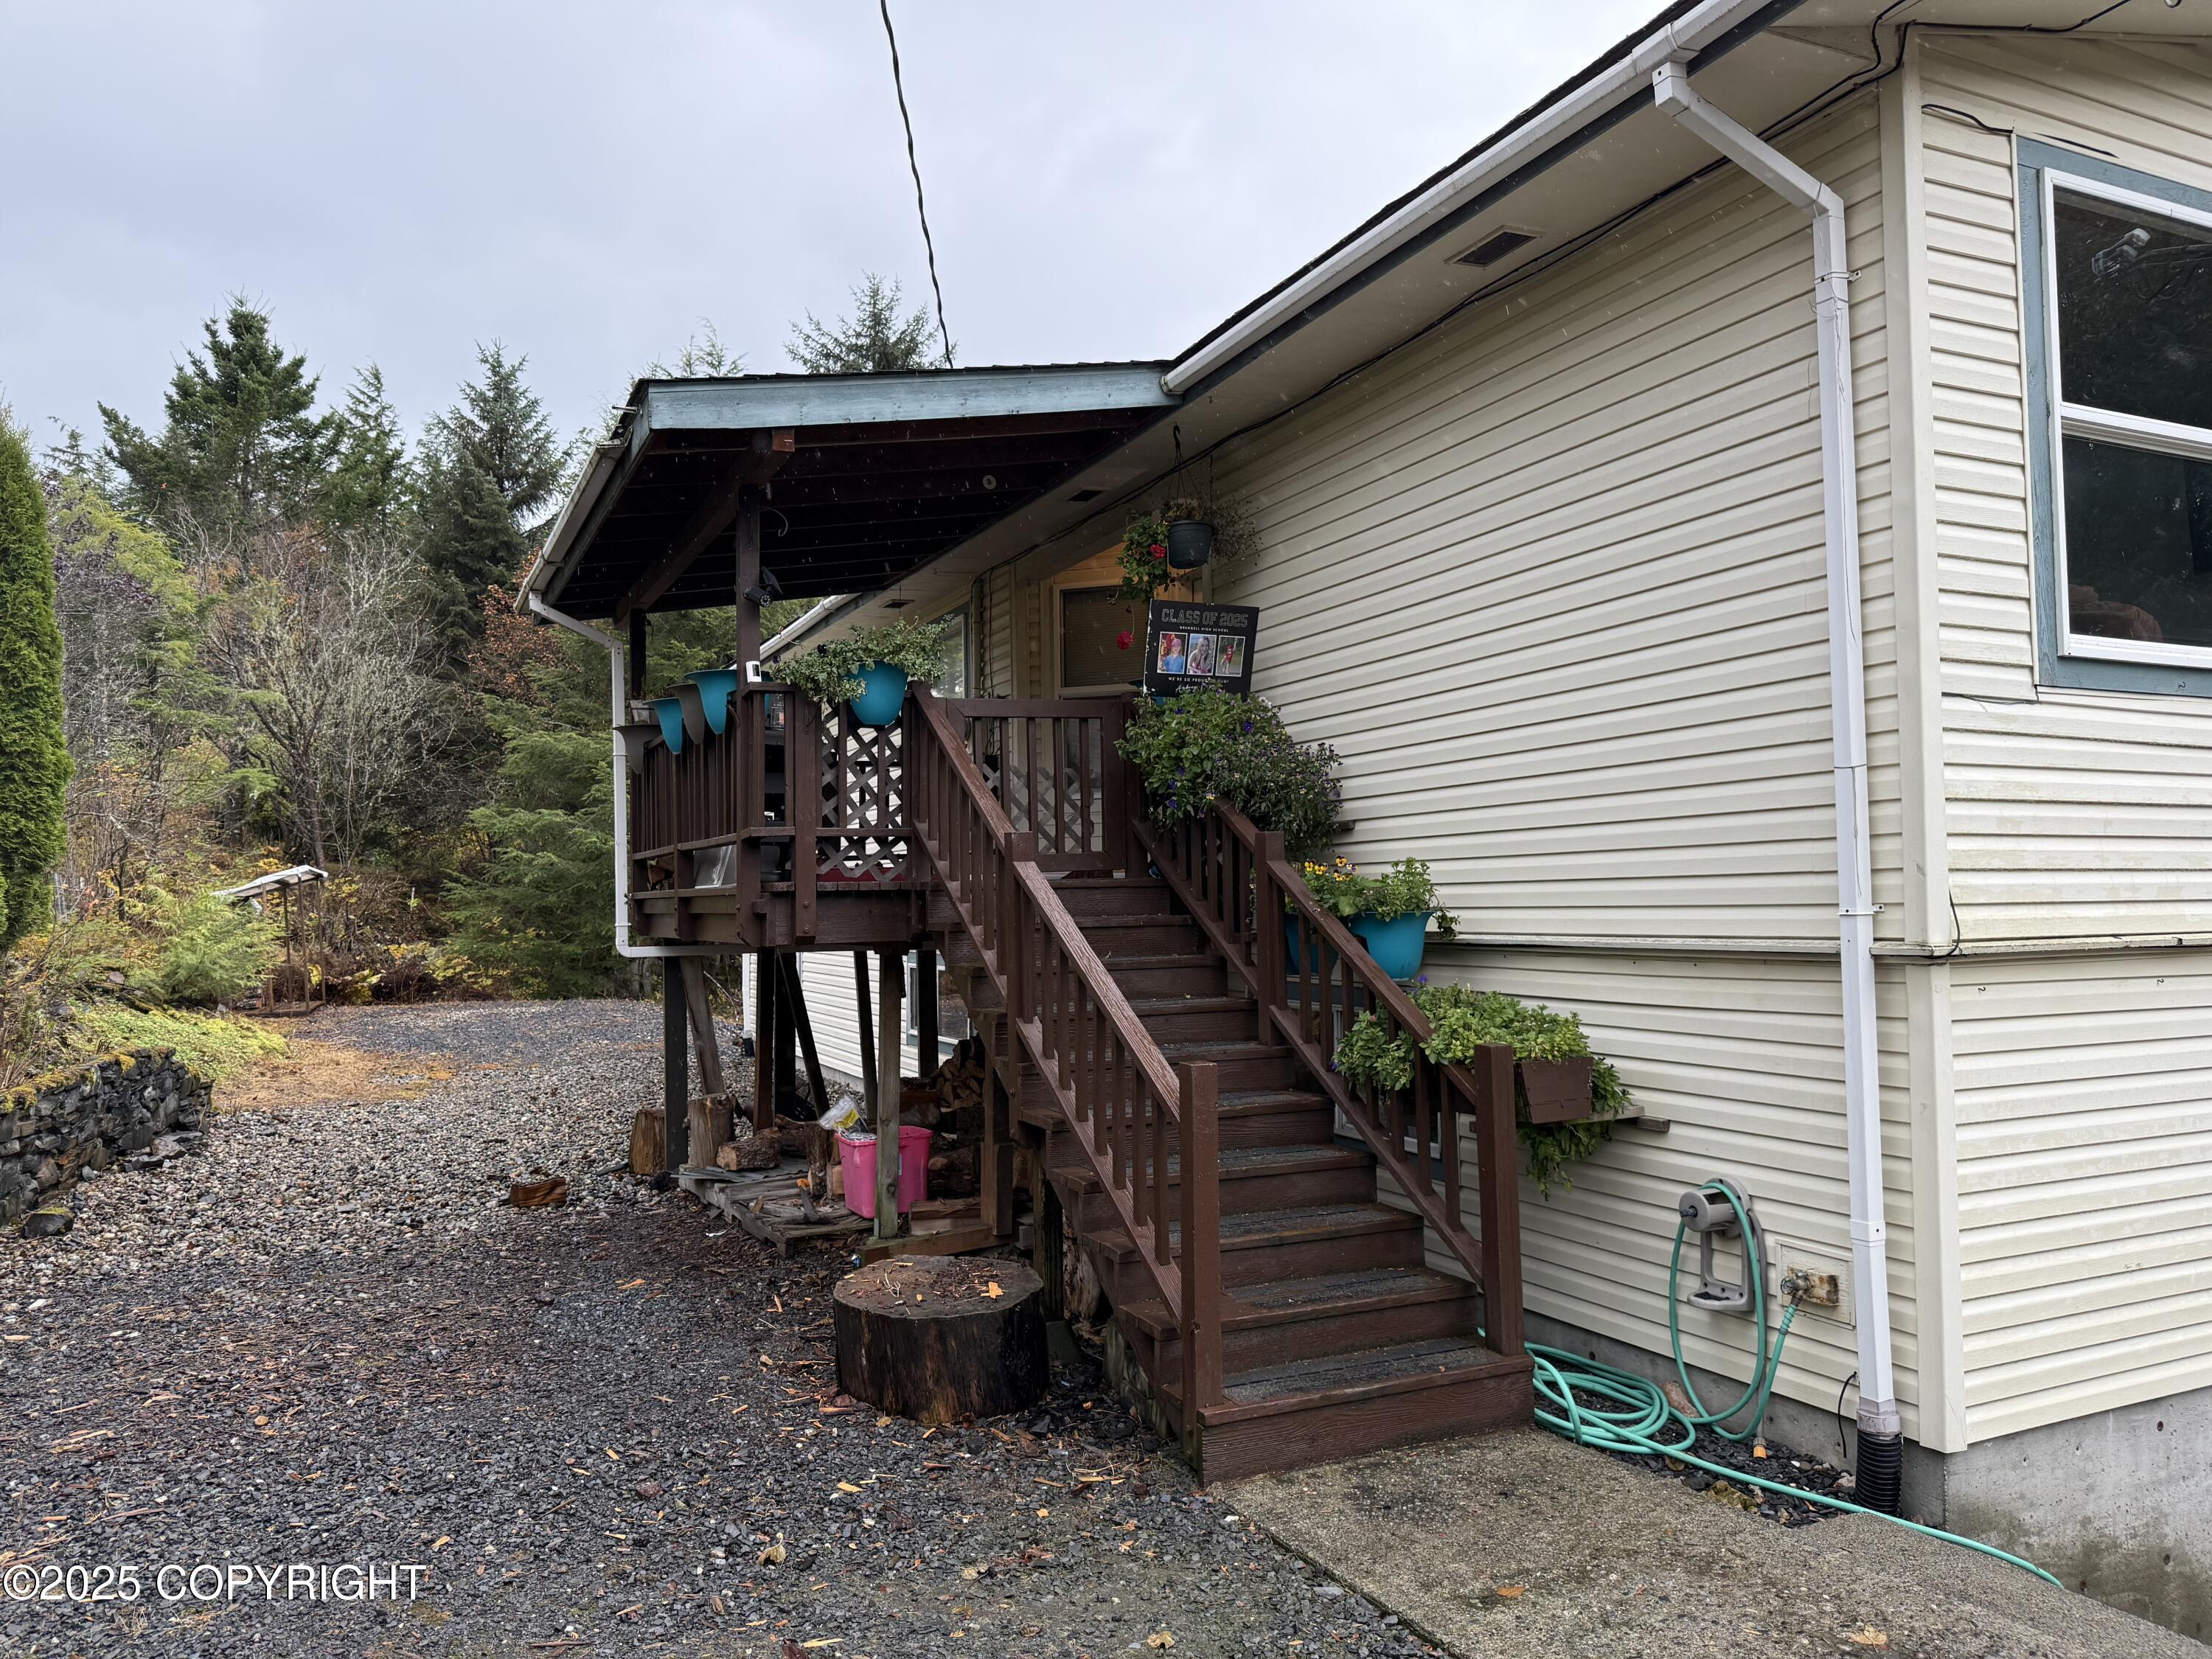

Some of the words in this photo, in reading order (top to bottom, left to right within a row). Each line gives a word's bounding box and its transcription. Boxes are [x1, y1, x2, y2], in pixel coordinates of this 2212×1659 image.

[1161, 609, 1200, 624] CLASS
[1203, 612, 1218, 625] OF
[1220, 613, 1248, 627] 2025
